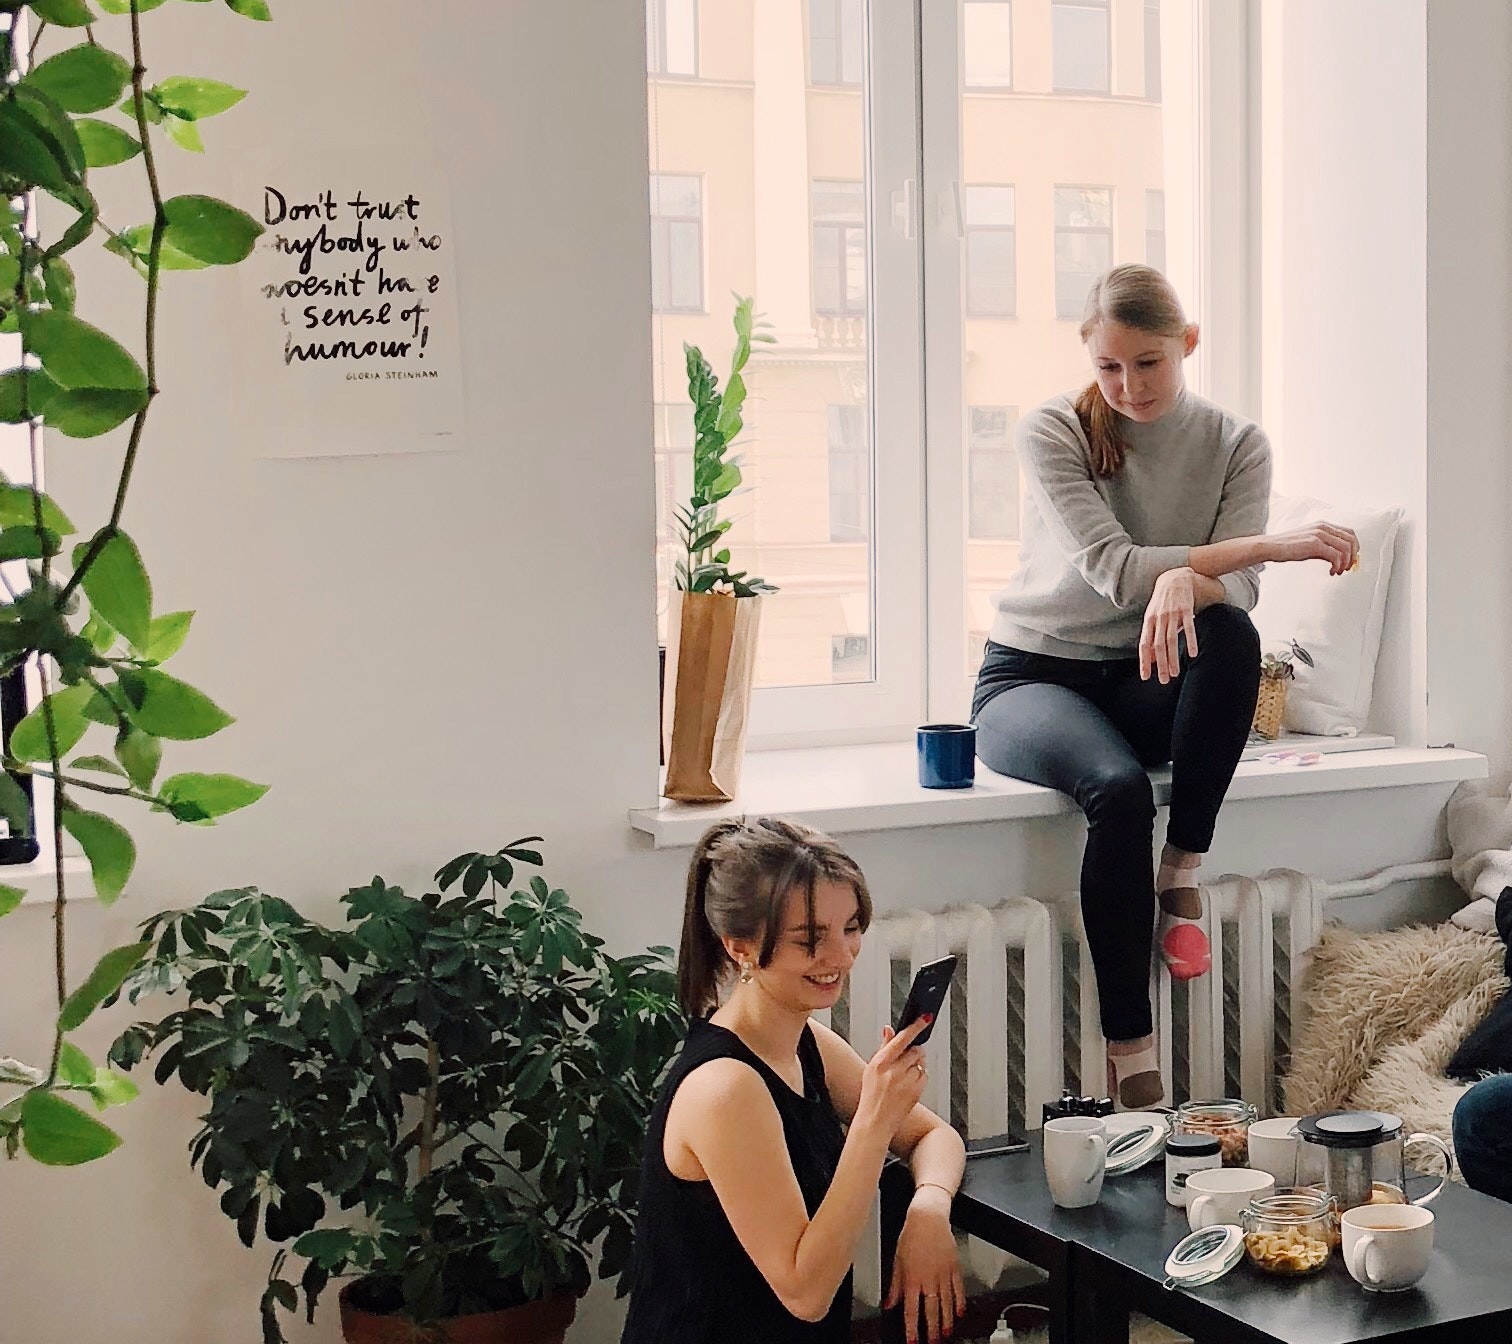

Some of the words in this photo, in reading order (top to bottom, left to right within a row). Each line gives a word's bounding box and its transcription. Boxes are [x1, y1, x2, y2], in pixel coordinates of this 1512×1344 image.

[265, 186, 338, 226] Don't
[266, 220, 387, 275] nybody
[378, 267, 440, 295] hae
[400, 299, 430, 338] of
[284, 326, 429, 366] humour!
[346, 372, 380, 380] GLORIA
